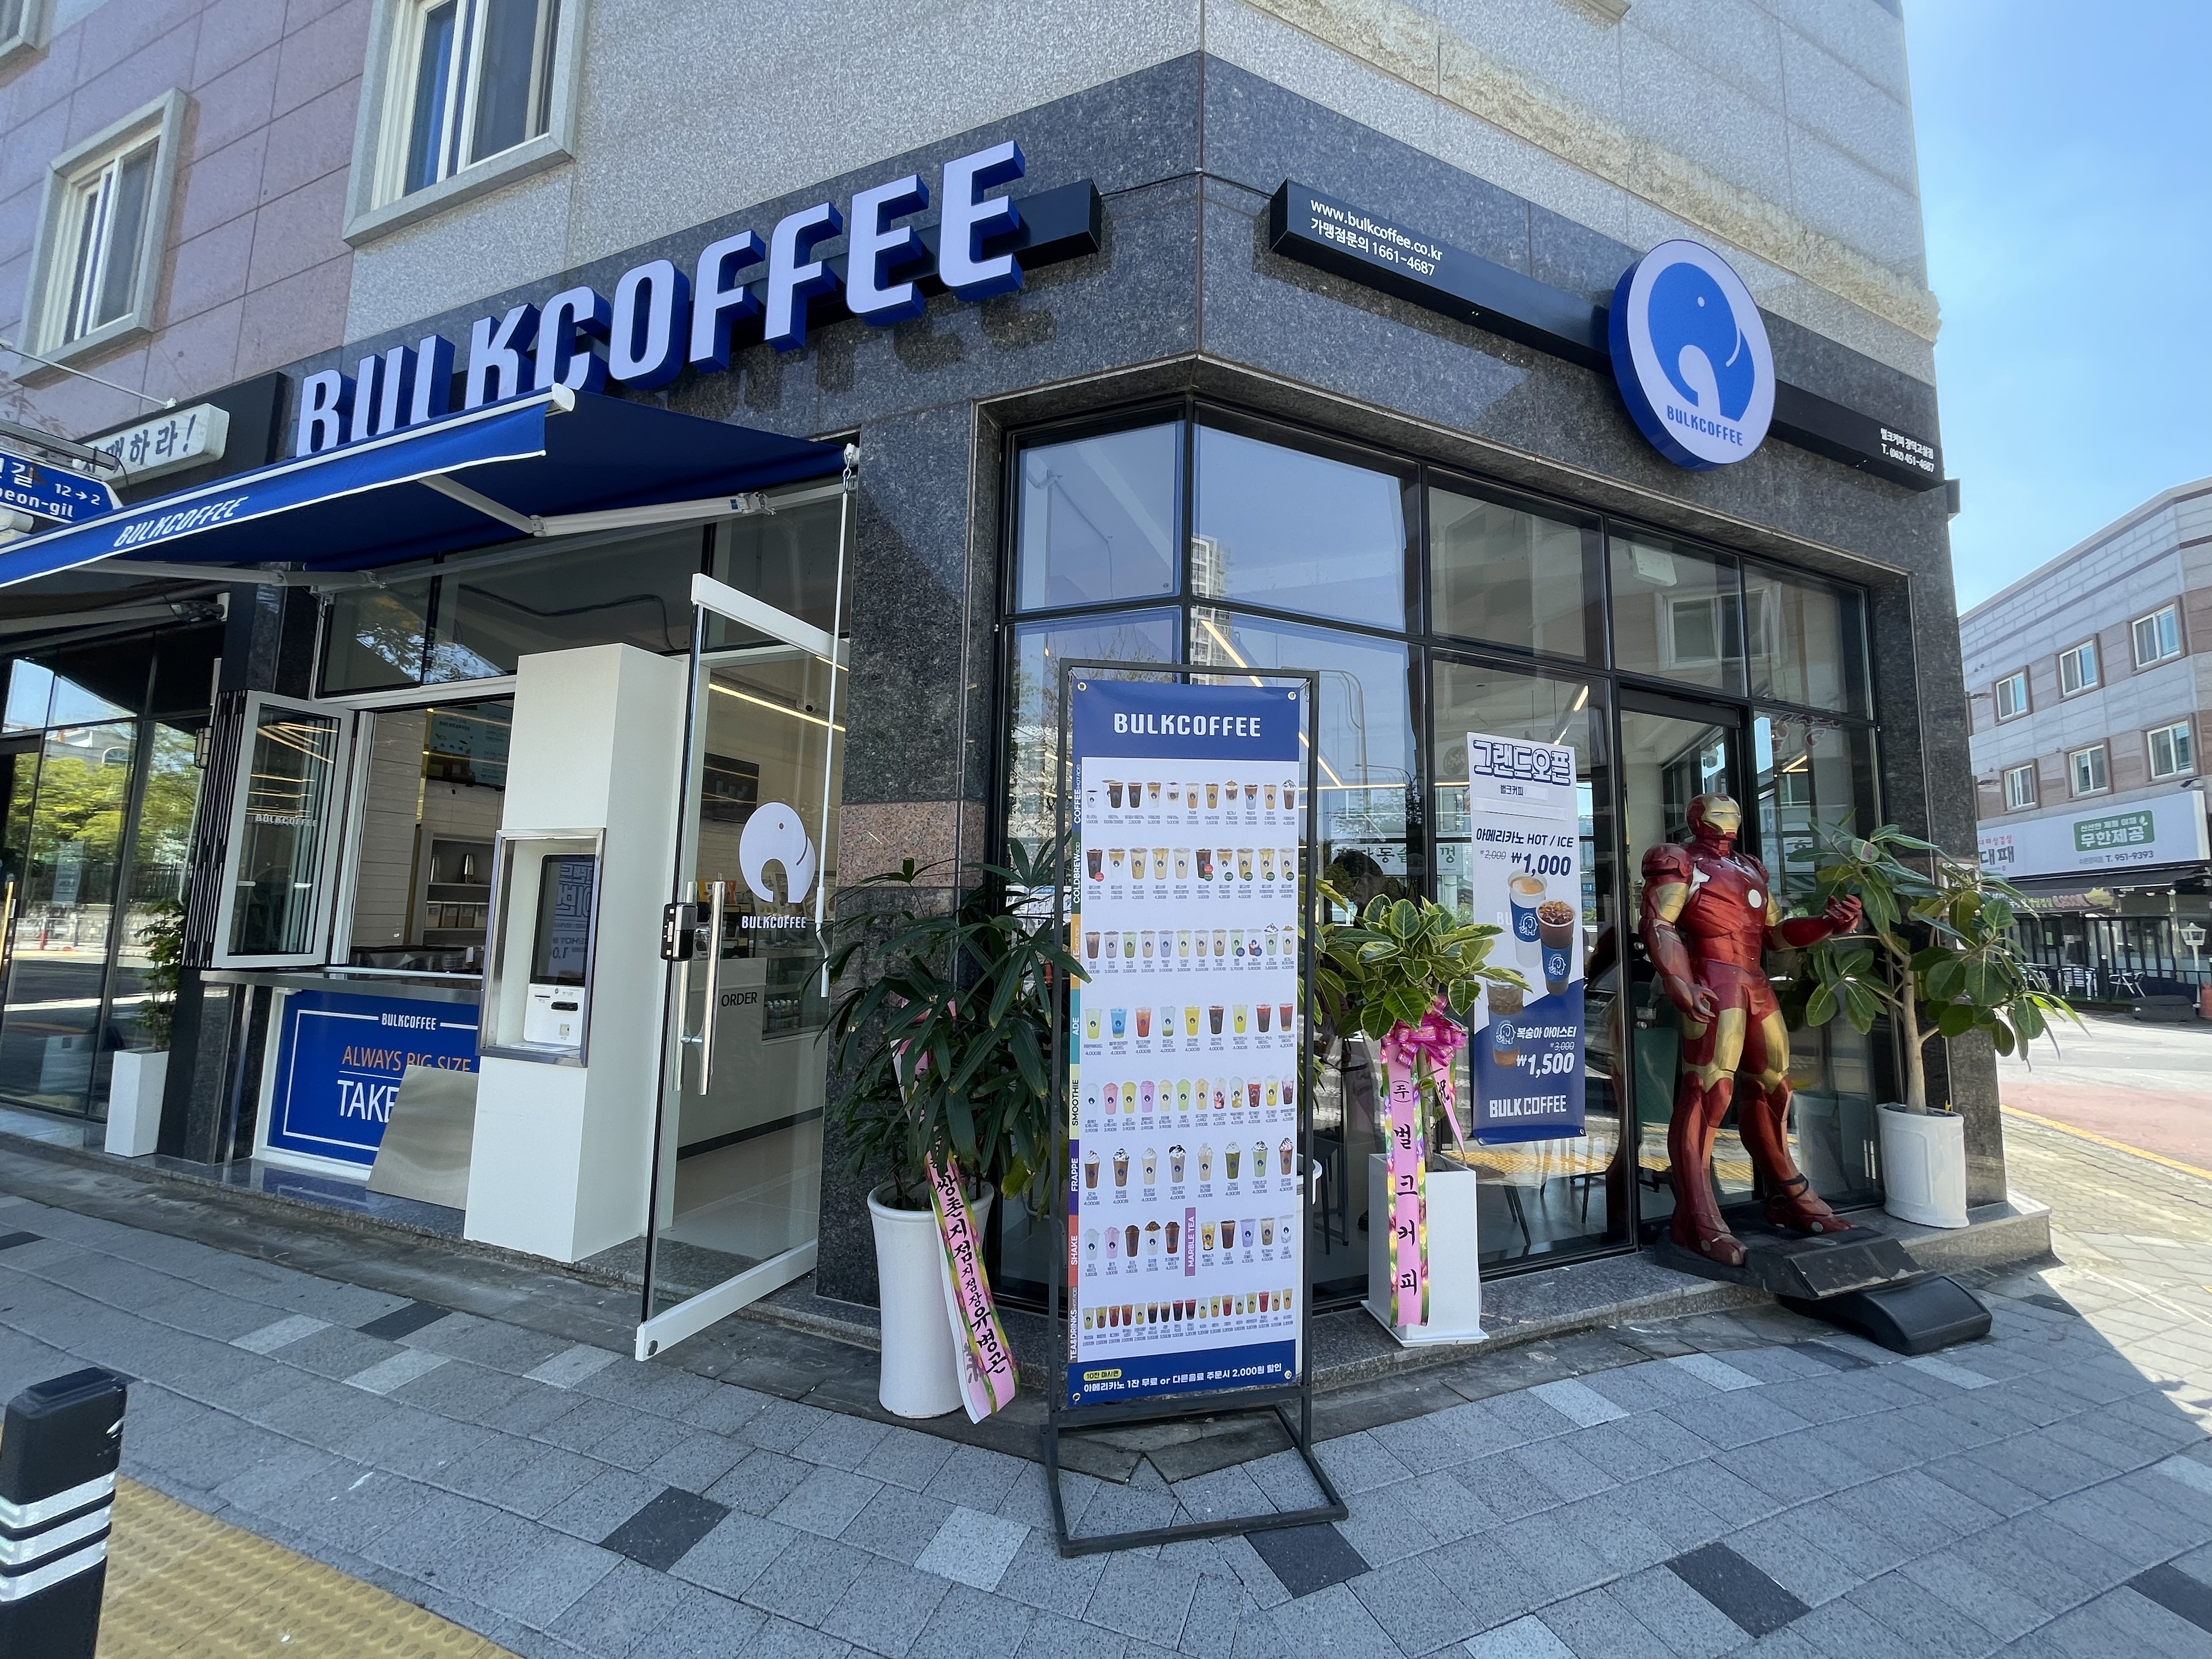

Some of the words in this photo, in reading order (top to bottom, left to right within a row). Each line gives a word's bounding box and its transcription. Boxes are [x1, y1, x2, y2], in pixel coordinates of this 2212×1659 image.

[1310, 200, 1443, 261] www.bulkcoffee.co.kr
[1311, 218, 1369, 253] 가맹점문의
[1372, 241, 1435, 276] 1661-4687
[296, 139, 1022, 456] BULKCOFFEE
[1667, 405, 1743, 447] BULKCOFFEE
[55, 483, 72, 498] 12
[91, 494, 101, 506] 2
[113, 495, 250, 548] BULKCOFFEE
[1114, 713, 1261, 737] BULKCOFFEE
[1473, 740, 1571, 787] 그랜드오픈
[1500, 784, 1524, 796] 벌크커피
[1476, 828, 1524, 845] 아메리카노
[1527, 833, 1548, 846] HOT
[1557, 836, 1574, 848] ICE
[2080, 826, 2144, 847] 무한제공
[2114, 850, 2154, 862] 951-9393
[742, 916, 806, 929] BULKCOFFEE
[721, 991, 758, 1007] ORDER
[381, 1013, 437, 1030] BULKCOFFEE
[1516, 1026, 1542, 1040] 복숭아
[1543, 1026, 1577, 1038] 아이스티
[341, 1045, 402, 1071] ALWAYS
[1084, 1381, 1125, 1392] 아메리카노
[1127, 1379, 1139, 1389] 1잔
[1142, 1378, 1158, 1387] 무료
[1172, 1373, 1205, 1384] 다른음료
[1206, 1369, 1230, 1380] 주문시
[1266, 1363, 1282, 1374] 할인
